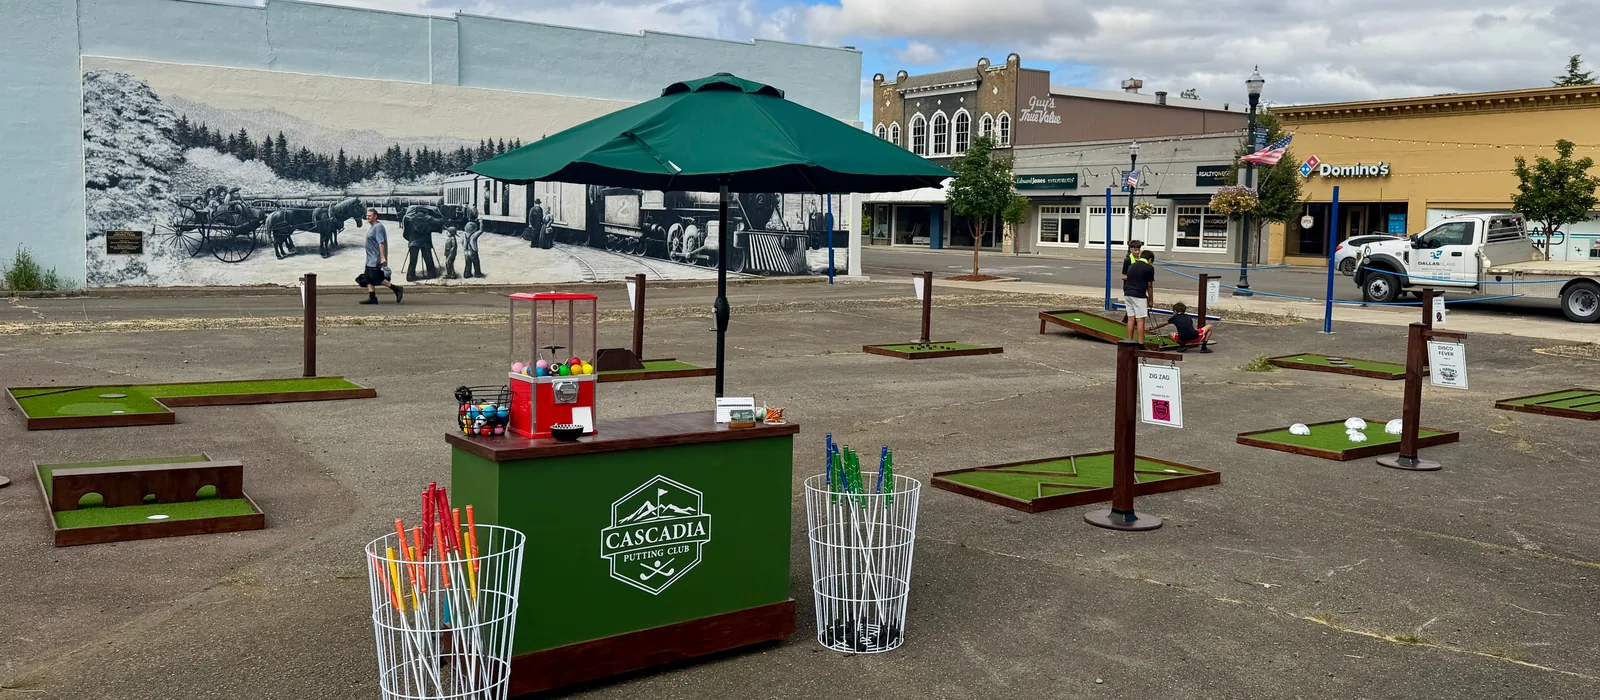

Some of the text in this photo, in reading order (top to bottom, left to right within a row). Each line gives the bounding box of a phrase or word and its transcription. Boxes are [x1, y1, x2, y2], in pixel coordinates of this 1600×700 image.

[1029, 96, 1056, 110] Guy's
[1320, 161, 1389, 176] Domino's
[757, 194, 764, 204] 2
[616, 199, 629, 219] 2
[605, 520, 706, 549] CASCADIA
[623, 545, 690, 562] PUTTING CLUB
